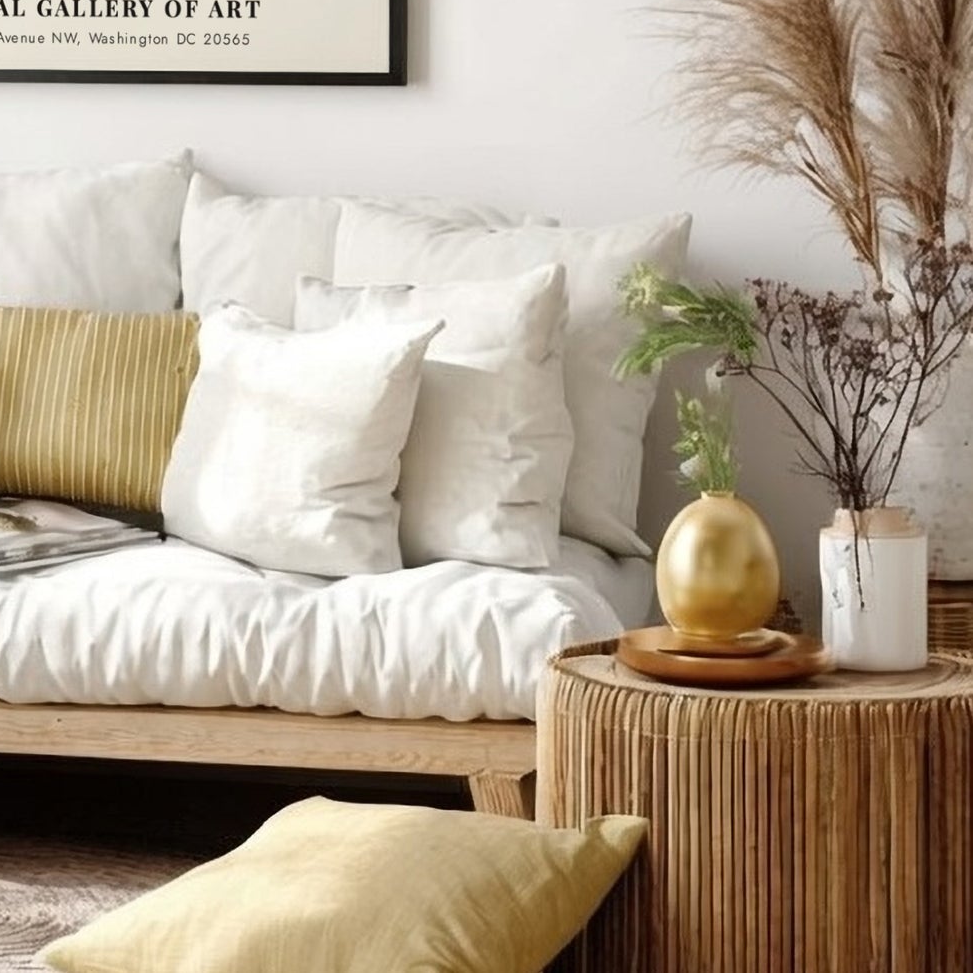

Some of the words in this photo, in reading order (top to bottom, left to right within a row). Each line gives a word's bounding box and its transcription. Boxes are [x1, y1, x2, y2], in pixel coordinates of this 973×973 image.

[37, 0, 153, 18] GALLERY
[164, 0, 198, 18] OF
[208, 0, 260, 19] ART
[52, 32, 80, 46] NW,
[89, 31, 168, 48] Washington
[177, 33, 195, 45] DC
[204, 33, 250, 45] 20565
